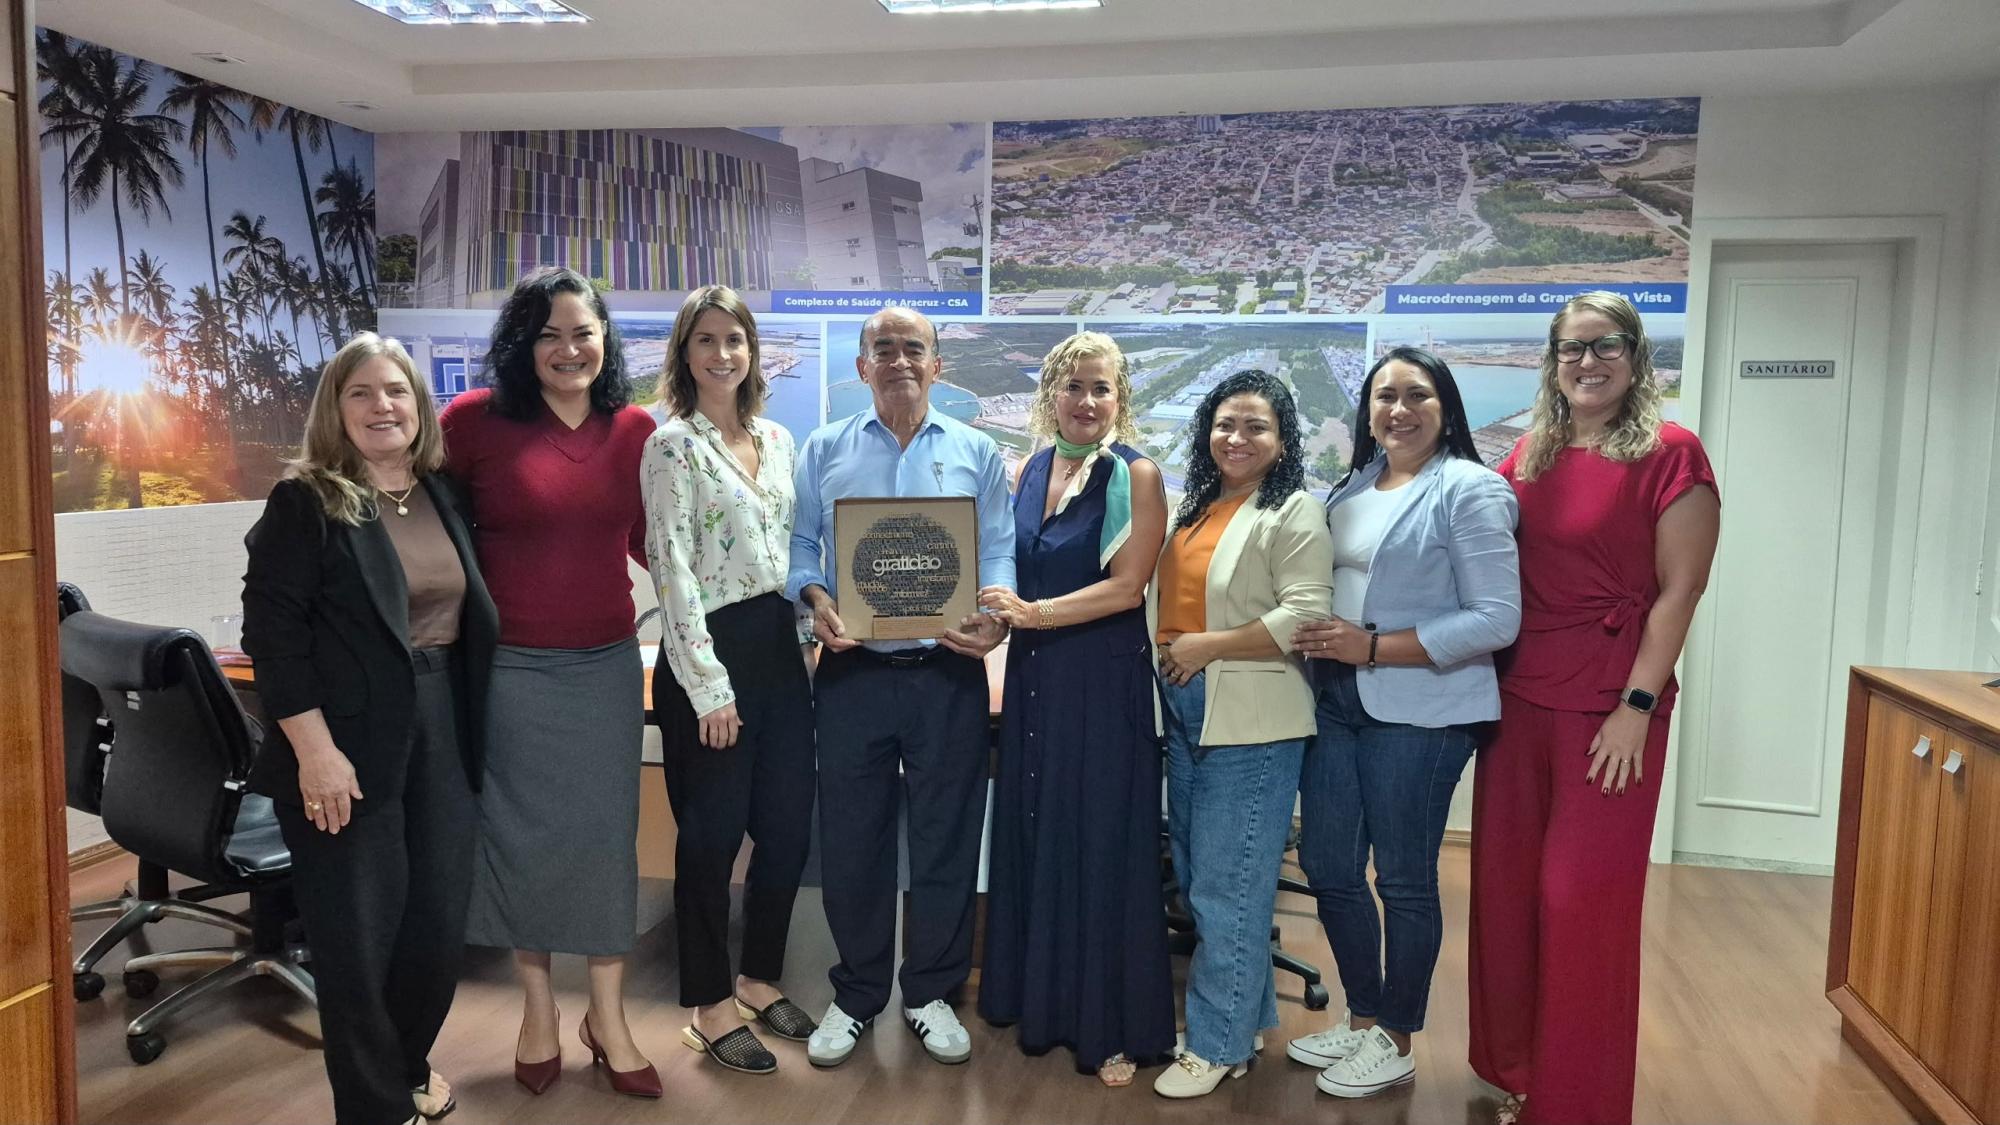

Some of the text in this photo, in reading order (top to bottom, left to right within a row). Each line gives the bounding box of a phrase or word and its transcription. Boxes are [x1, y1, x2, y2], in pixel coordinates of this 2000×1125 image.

[776, 201, 801, 216] CSA
[784, 297, 834, 307] Complexo
[836, 297, 849, 306] de
[851, 297, 882, 307] Saúde
[884, 297, 897, 307] de
[899, 298, 939, 307] Aracruz
[947, 298, 968, 307] CSA
[1398, 293, 1514, 306] Macrodrenagem
[1518, 293, 1536, 303] da
[1633, 292, 1672, 303] Vista
[1746, 362, 1827, 374] SANITÁRIO
[872, 553, 941, 576] gratidão
